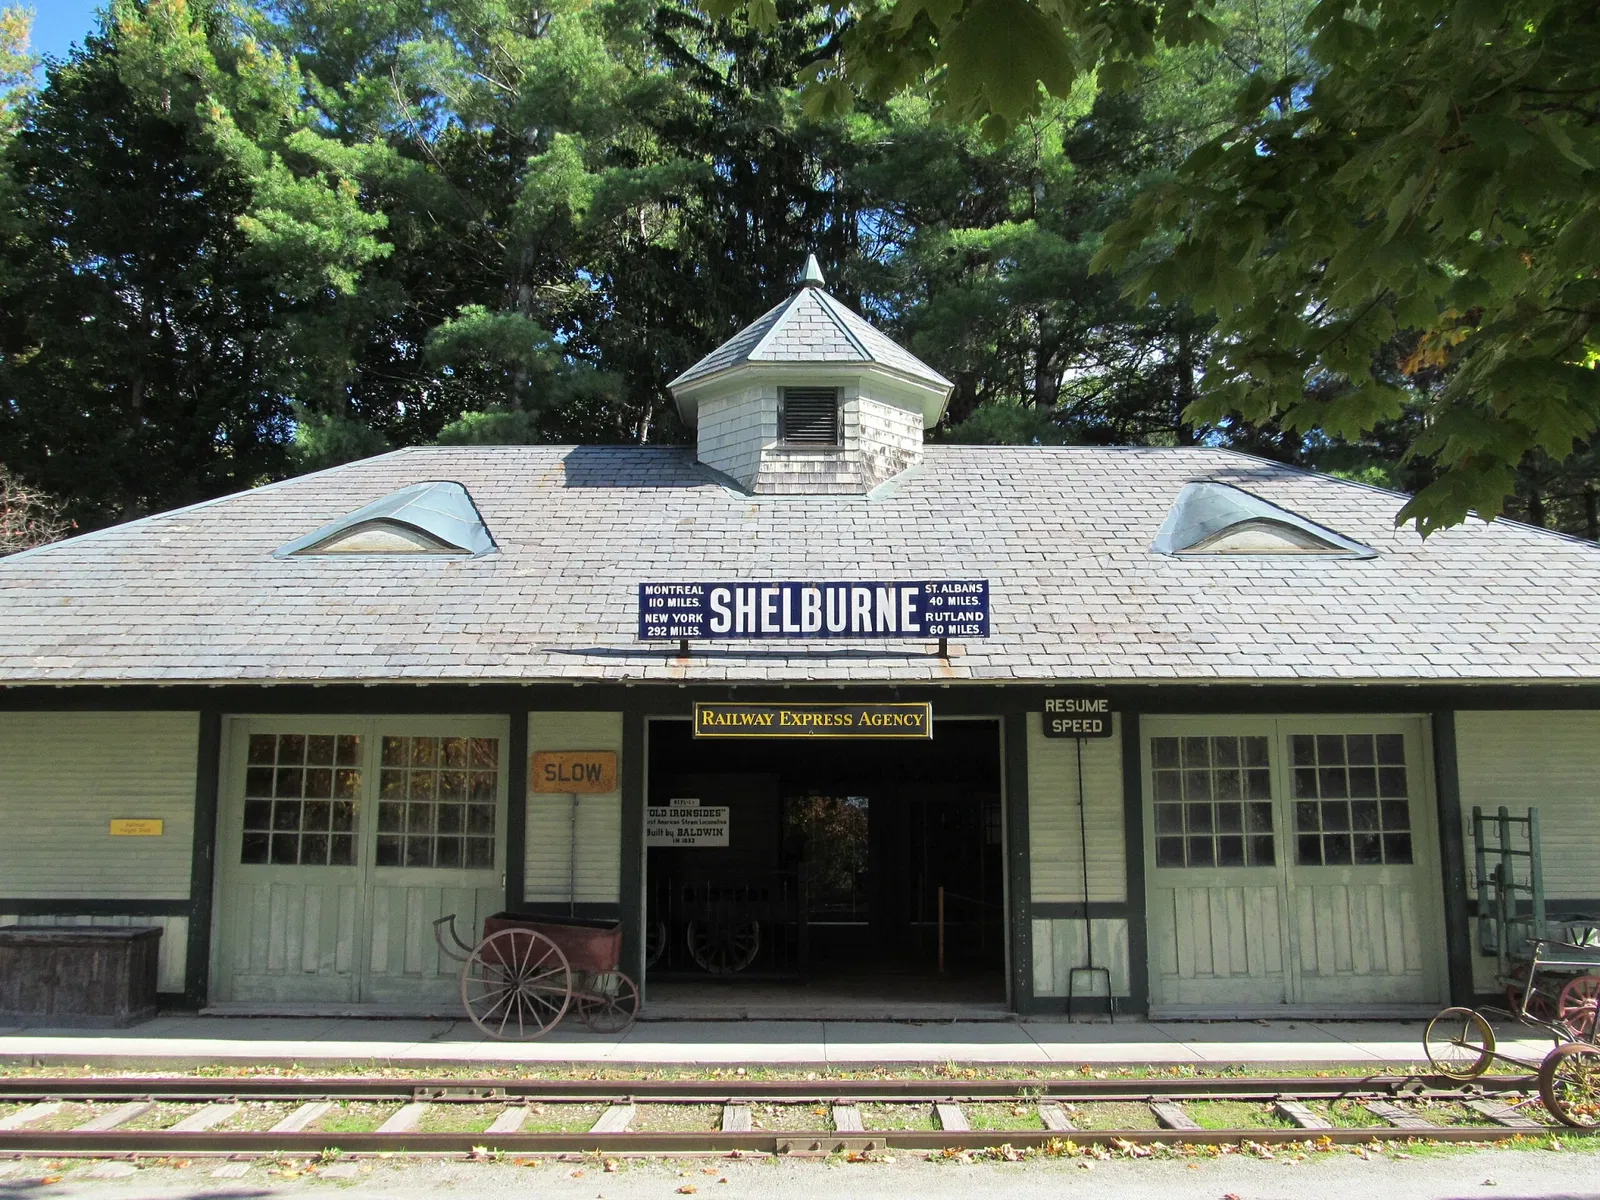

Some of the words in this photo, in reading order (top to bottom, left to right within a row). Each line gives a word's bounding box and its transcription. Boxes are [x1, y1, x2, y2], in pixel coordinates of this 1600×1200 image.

[645, 585, 704, 595] MONTREAL
[925, 584, 940, 593] ST.
[941, 584, 983, 593] ALBANS
[649, 597, 664, 607] 110
[667, 597, 702, 607] MILES.
[929, 596, 943, 606] 40
[948, 596, 981, 606] MILES.
[709, 587, 921, 633] SHELBURNE
[645, 613, 669, 623] NEW
[672, 613, 704, 623] YORK
[925, 612, 984, 621] RUTLAND
[647, 626, 667, 636] 292
[670, 626, 702, 636] MILES.
[929, 625, 944, 634] 60
[948, 625, 983, 634] MILES.
[1045, 699, 1109, 712] RESUME
[702, 710, 775, 726] RAILWAY
[779, 710, 853, 727] EXPRESS
[857, 710, 924, 727] AGENCY
[1052, 719, 1103, 733] SPEED
[544, 763, 602, 782] SLOW
[647, 828, 664, 837] Built
[665, 828, 674, 839] by
[677, 828, 723, 837] BALDWIN
